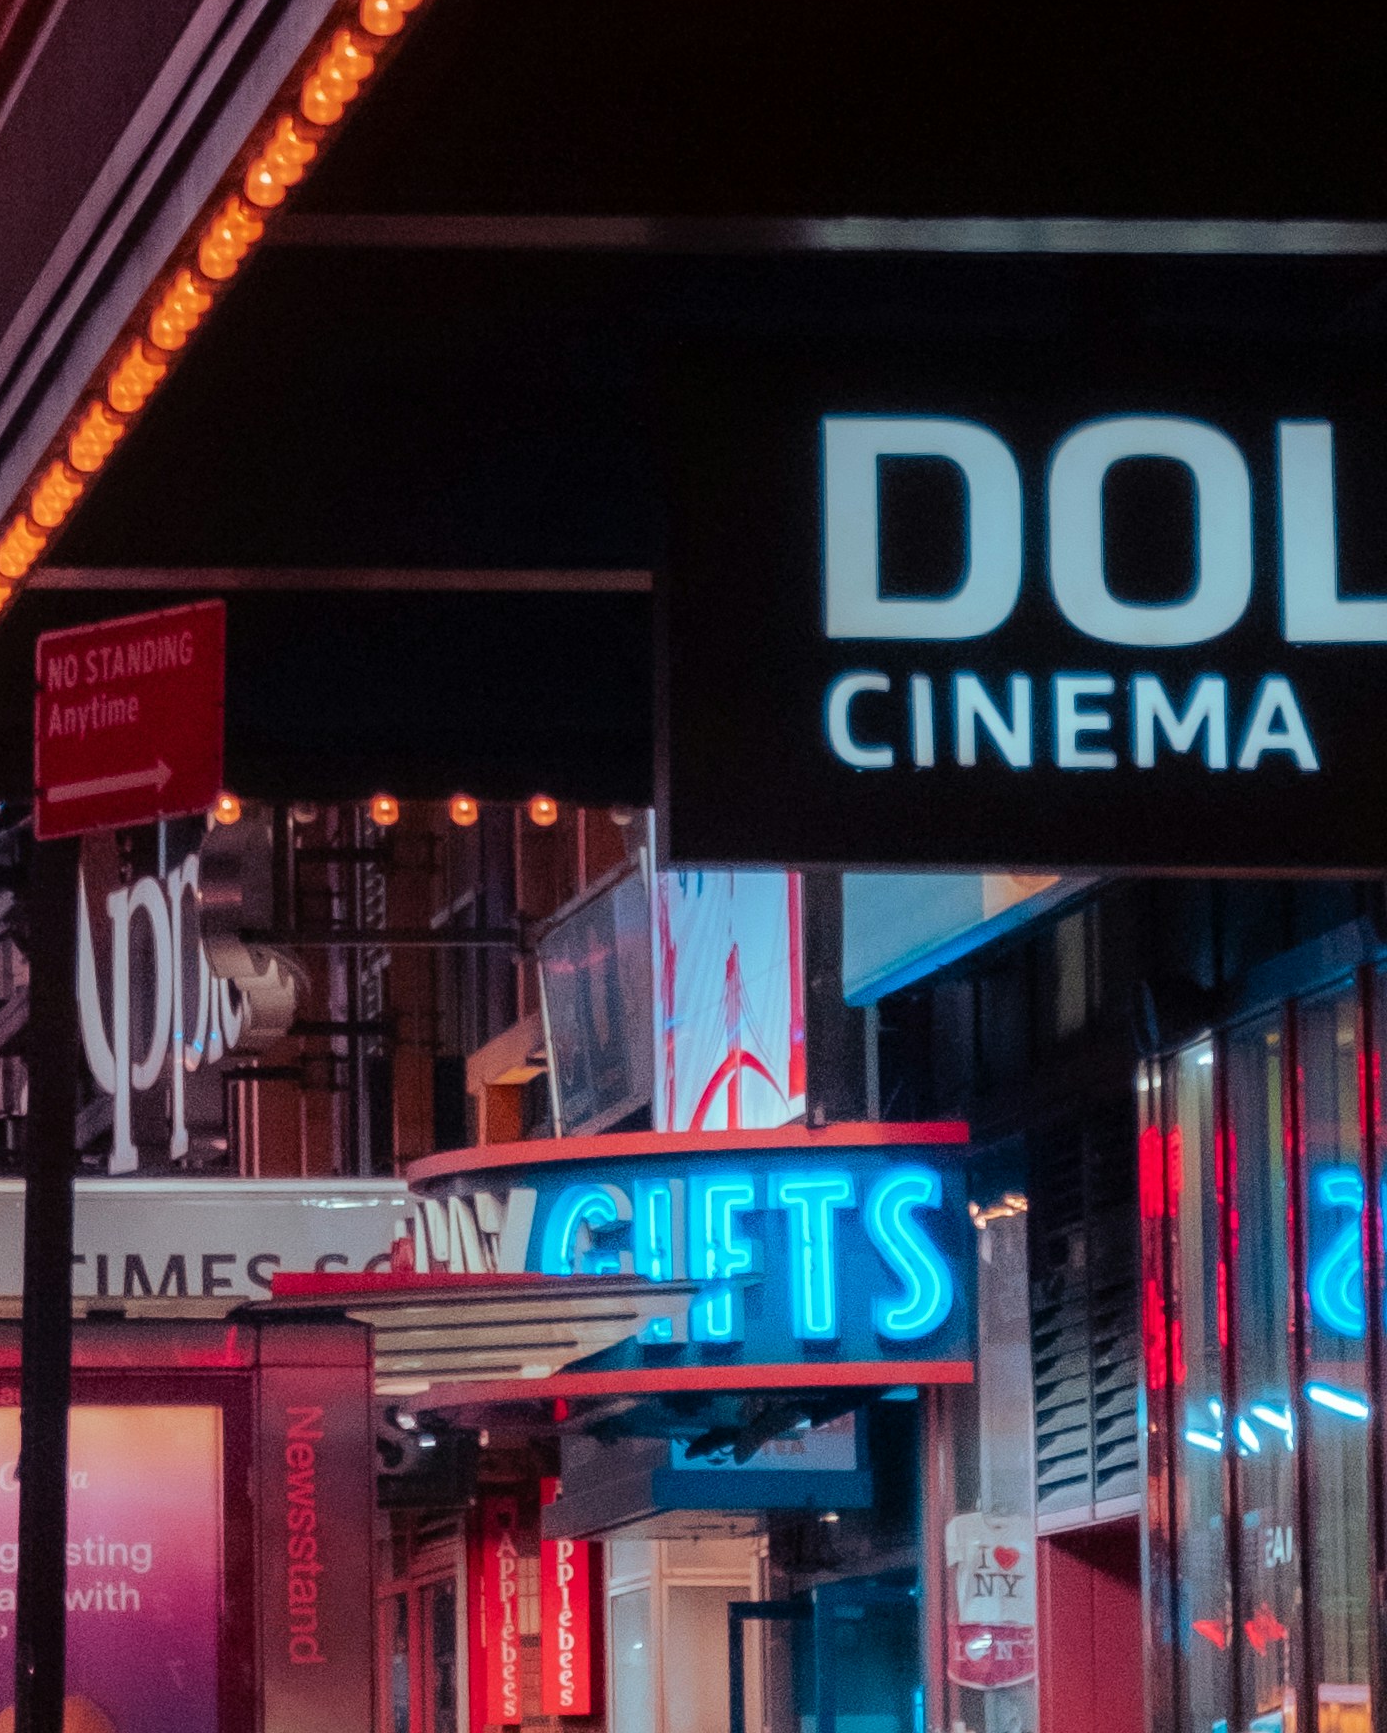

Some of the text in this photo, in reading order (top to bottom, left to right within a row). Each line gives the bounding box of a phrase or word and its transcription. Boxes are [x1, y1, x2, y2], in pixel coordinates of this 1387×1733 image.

[47, 631, 194, 691] NO STANDING
[48, 693, 140, 740] Anytime
[826, 671, 1321, 772] CINEMA
[539, 1163, 955, 1344] GIFTS
[65, 1537, 153, 1575] sting
[285, 1405, 326, 1664] Newsstand
[978, 1546, 988, 1569] I
[65, 1581, 141, 1612] with
[974, 1574, 1022, 1598] NY
